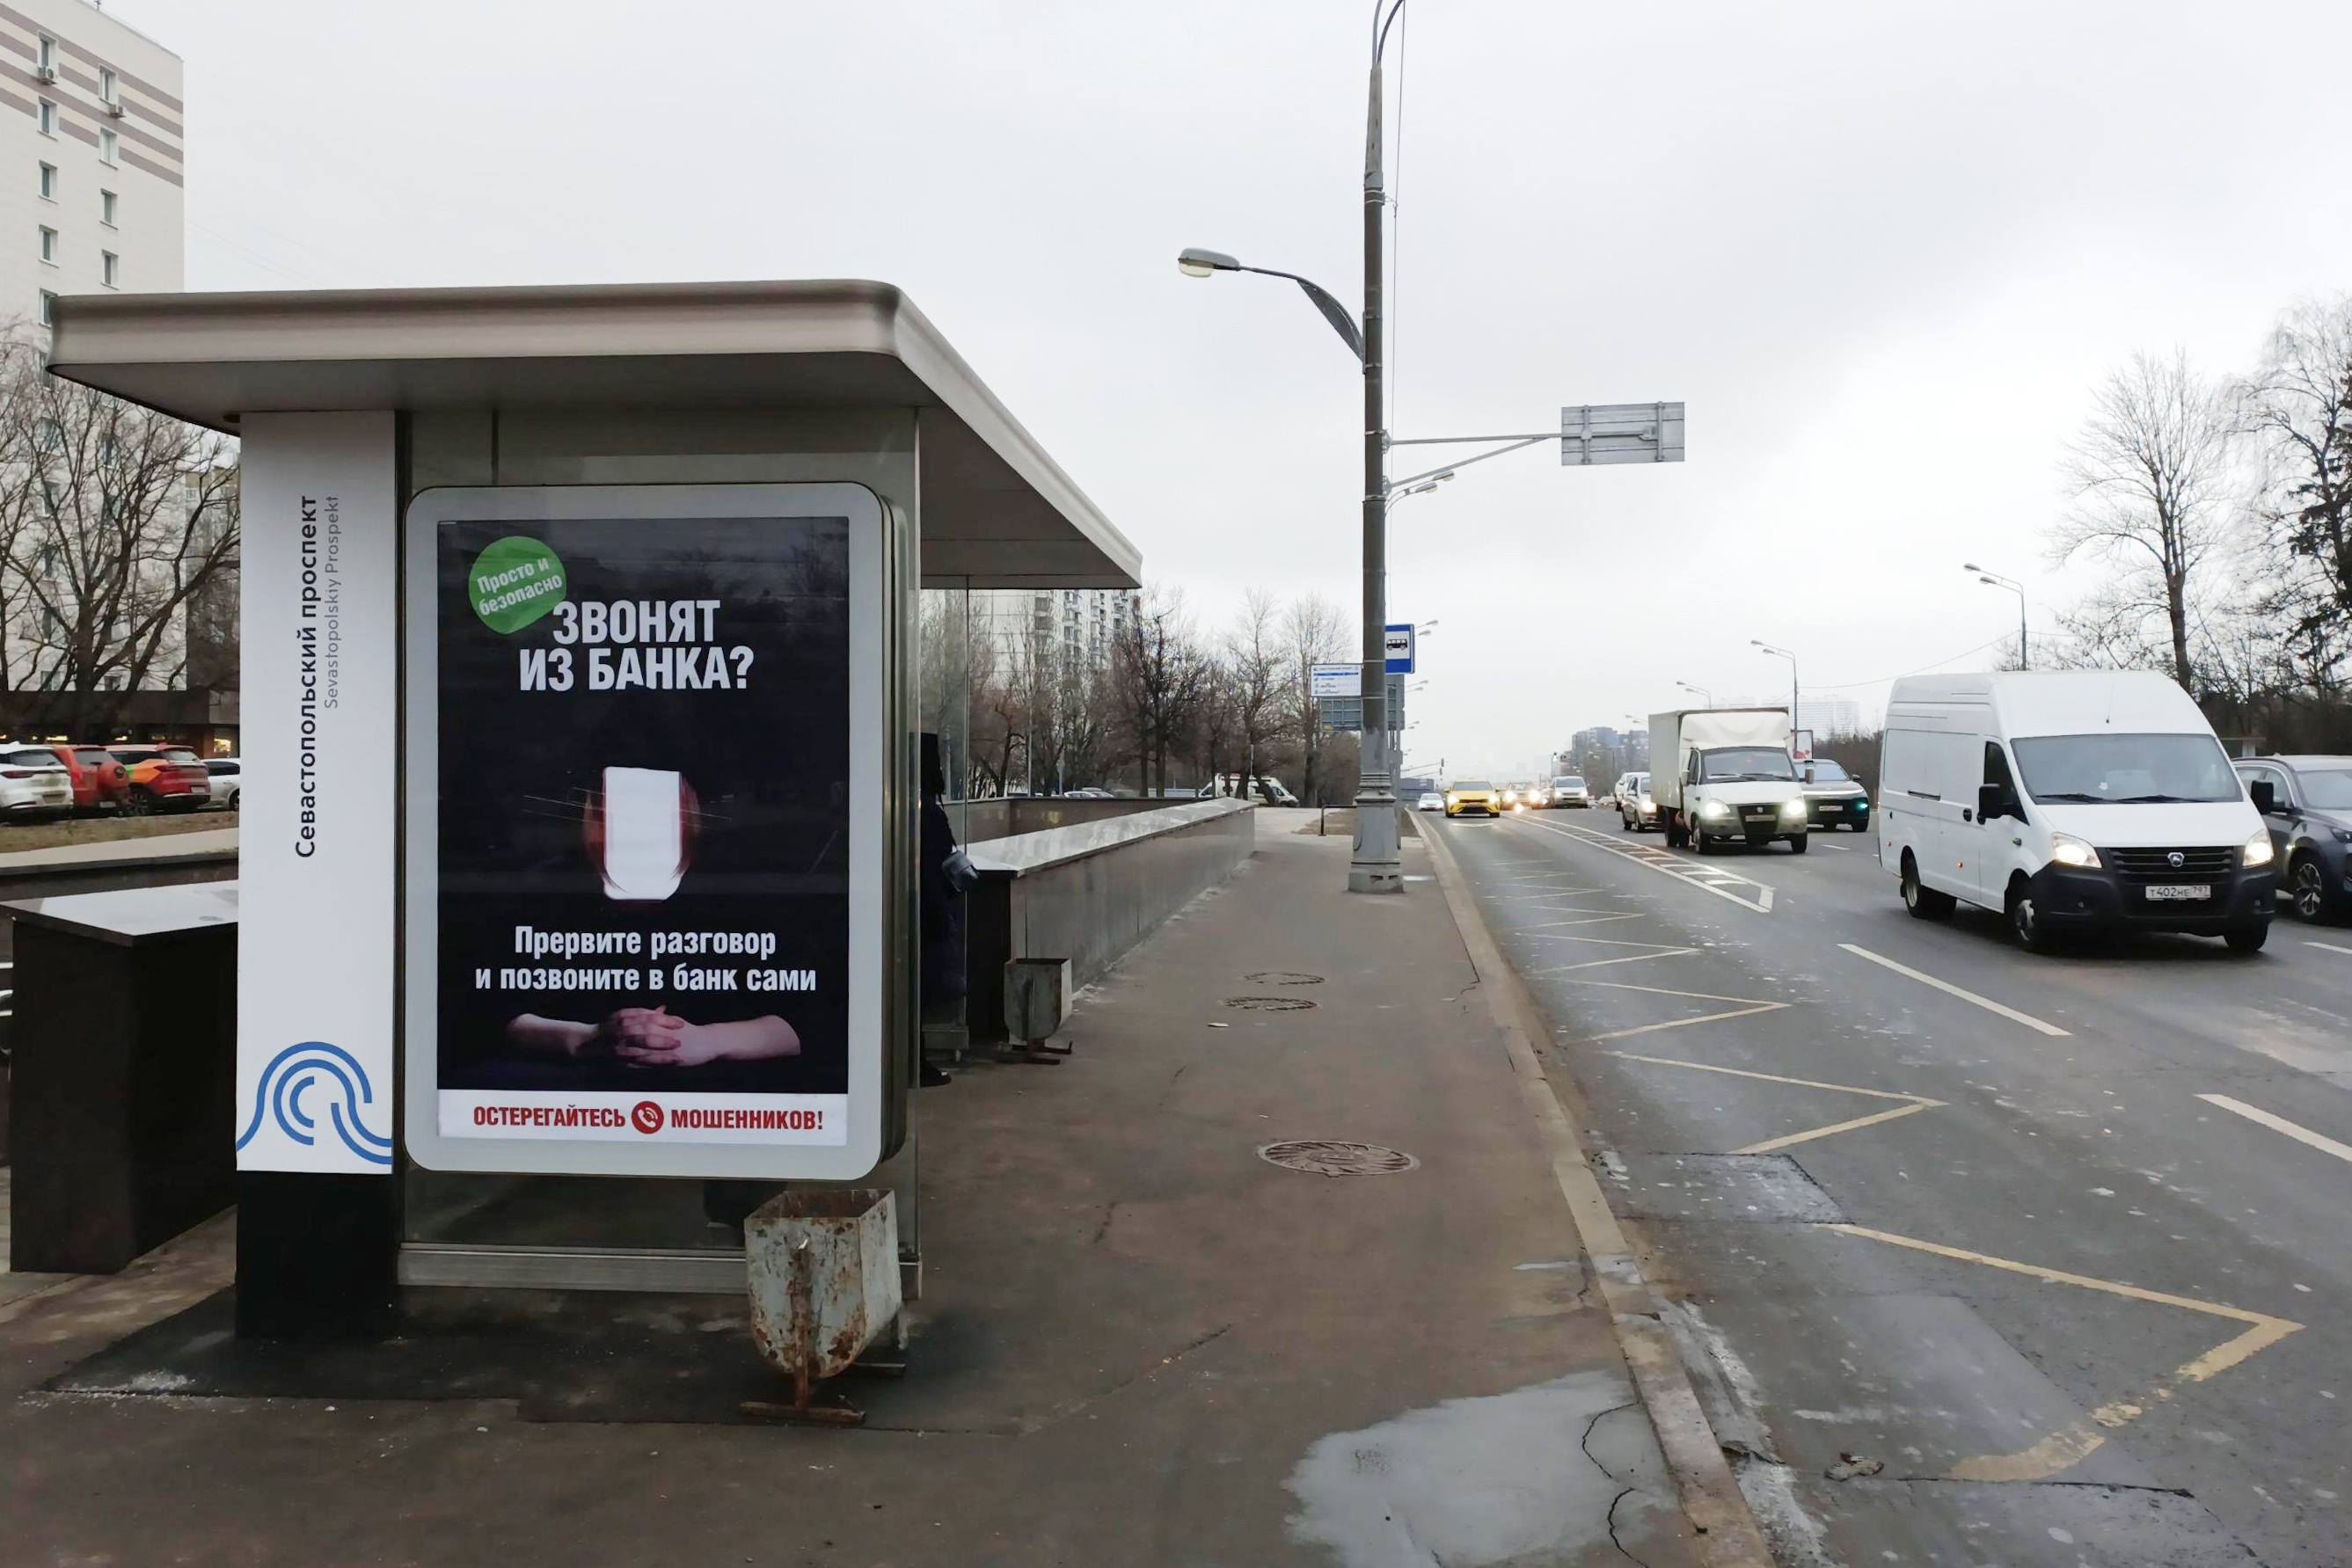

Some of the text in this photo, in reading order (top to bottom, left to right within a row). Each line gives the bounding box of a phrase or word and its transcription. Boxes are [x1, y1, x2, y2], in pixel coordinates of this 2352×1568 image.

[478, 558, 550, 594] Просто и
[478, 573, 563, 616] безопасно
[325, 495, 342, 709] Sevastopolskiy Prospekt
[552, 599, 721, 645] ЗВОНЯТ
[296, 495, 322, 858] Севастопольский проспект
[519, 646, 755, 692] ИЗ БАНКА?
[515, 926, 776, 960] Прервите разговор
[475, 962, 816, 992] и позвоните в банк сами
[473, 1104, 823, 1131] ОСТЕРЕГАЙТЕСЬ МОШЕННИКОВ!
